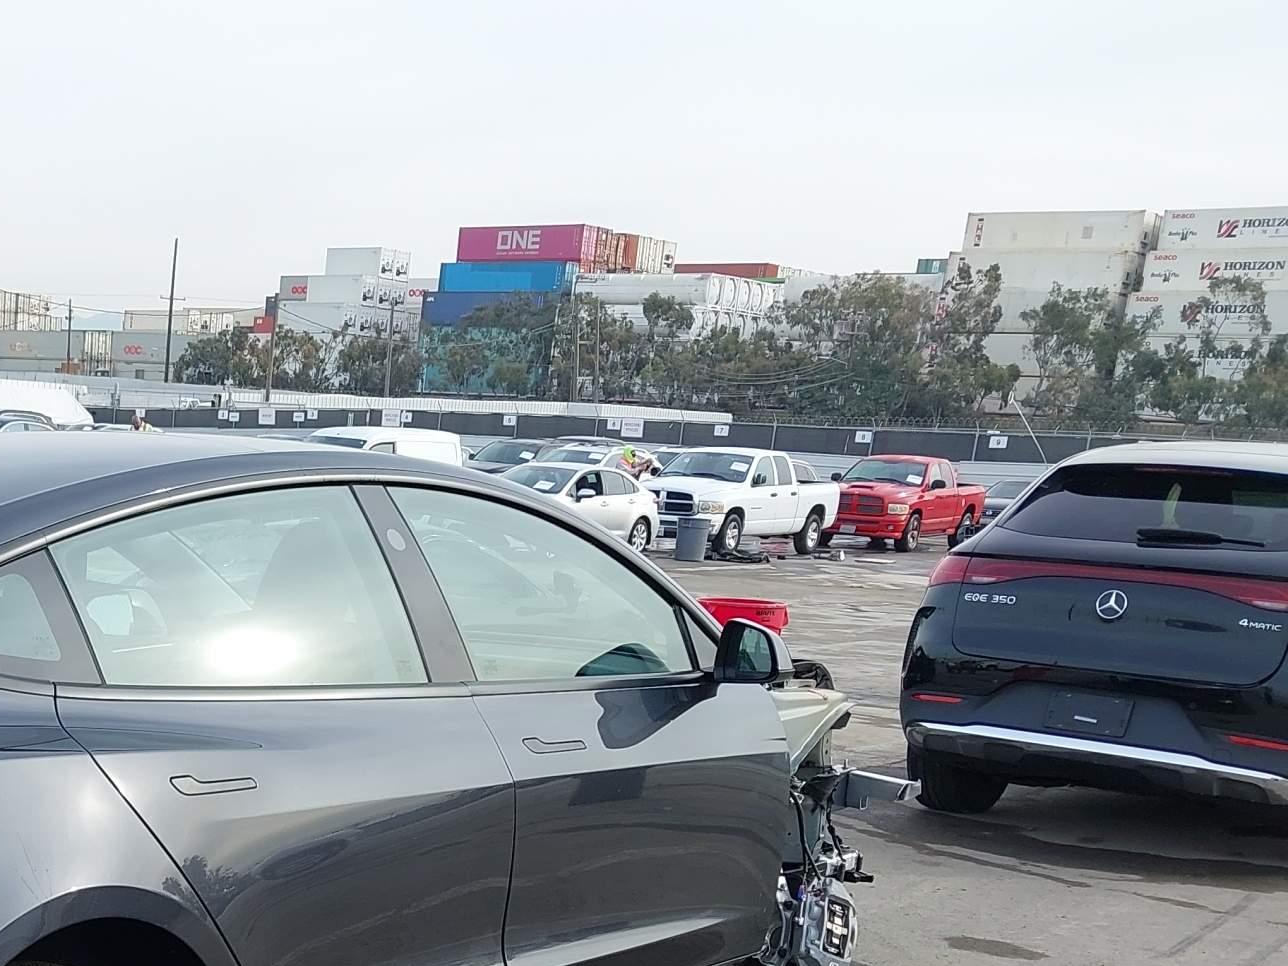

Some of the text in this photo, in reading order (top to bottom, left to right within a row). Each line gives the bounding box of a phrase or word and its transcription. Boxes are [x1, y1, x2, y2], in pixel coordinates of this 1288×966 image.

[1242, 217, 1288, 228] HORIZO
[496, 230, 541, 250] ONE
[1223, 260, 1286, 271] HORIZON
[964, 592, 1016, 605] EQE 350
[1238, 618, 1282, 631] 4MATIC
